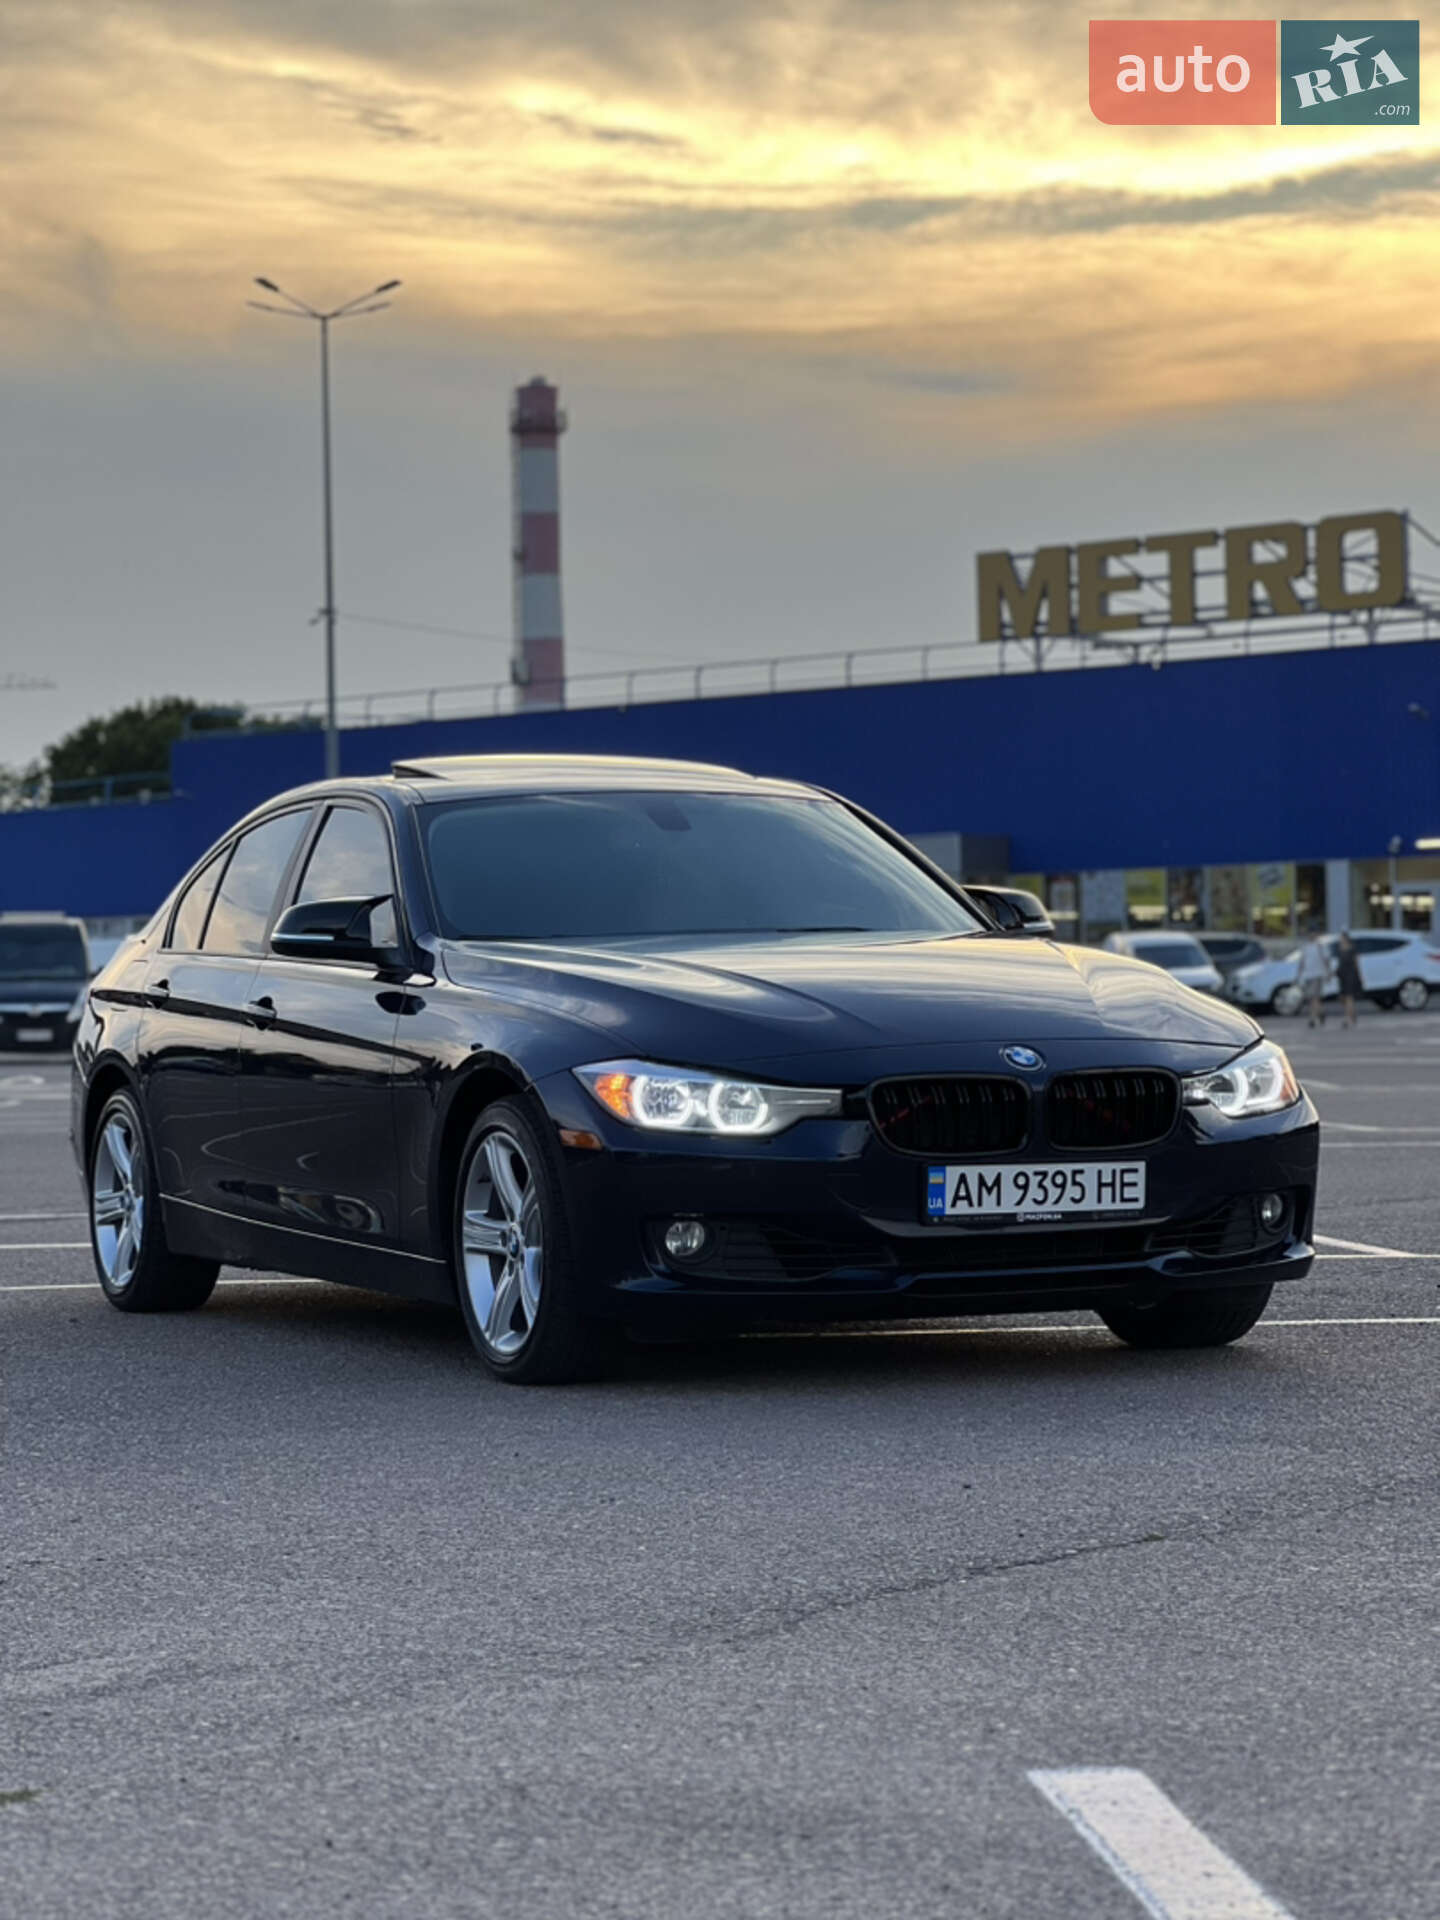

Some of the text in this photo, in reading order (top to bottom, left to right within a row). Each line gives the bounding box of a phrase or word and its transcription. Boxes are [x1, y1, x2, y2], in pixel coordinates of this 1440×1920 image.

[976, 510, 1408, 643] METRO
[928, 1197, 944, 1209] UA
[950, 1167, 1140, 1208] AM 9395 HE
